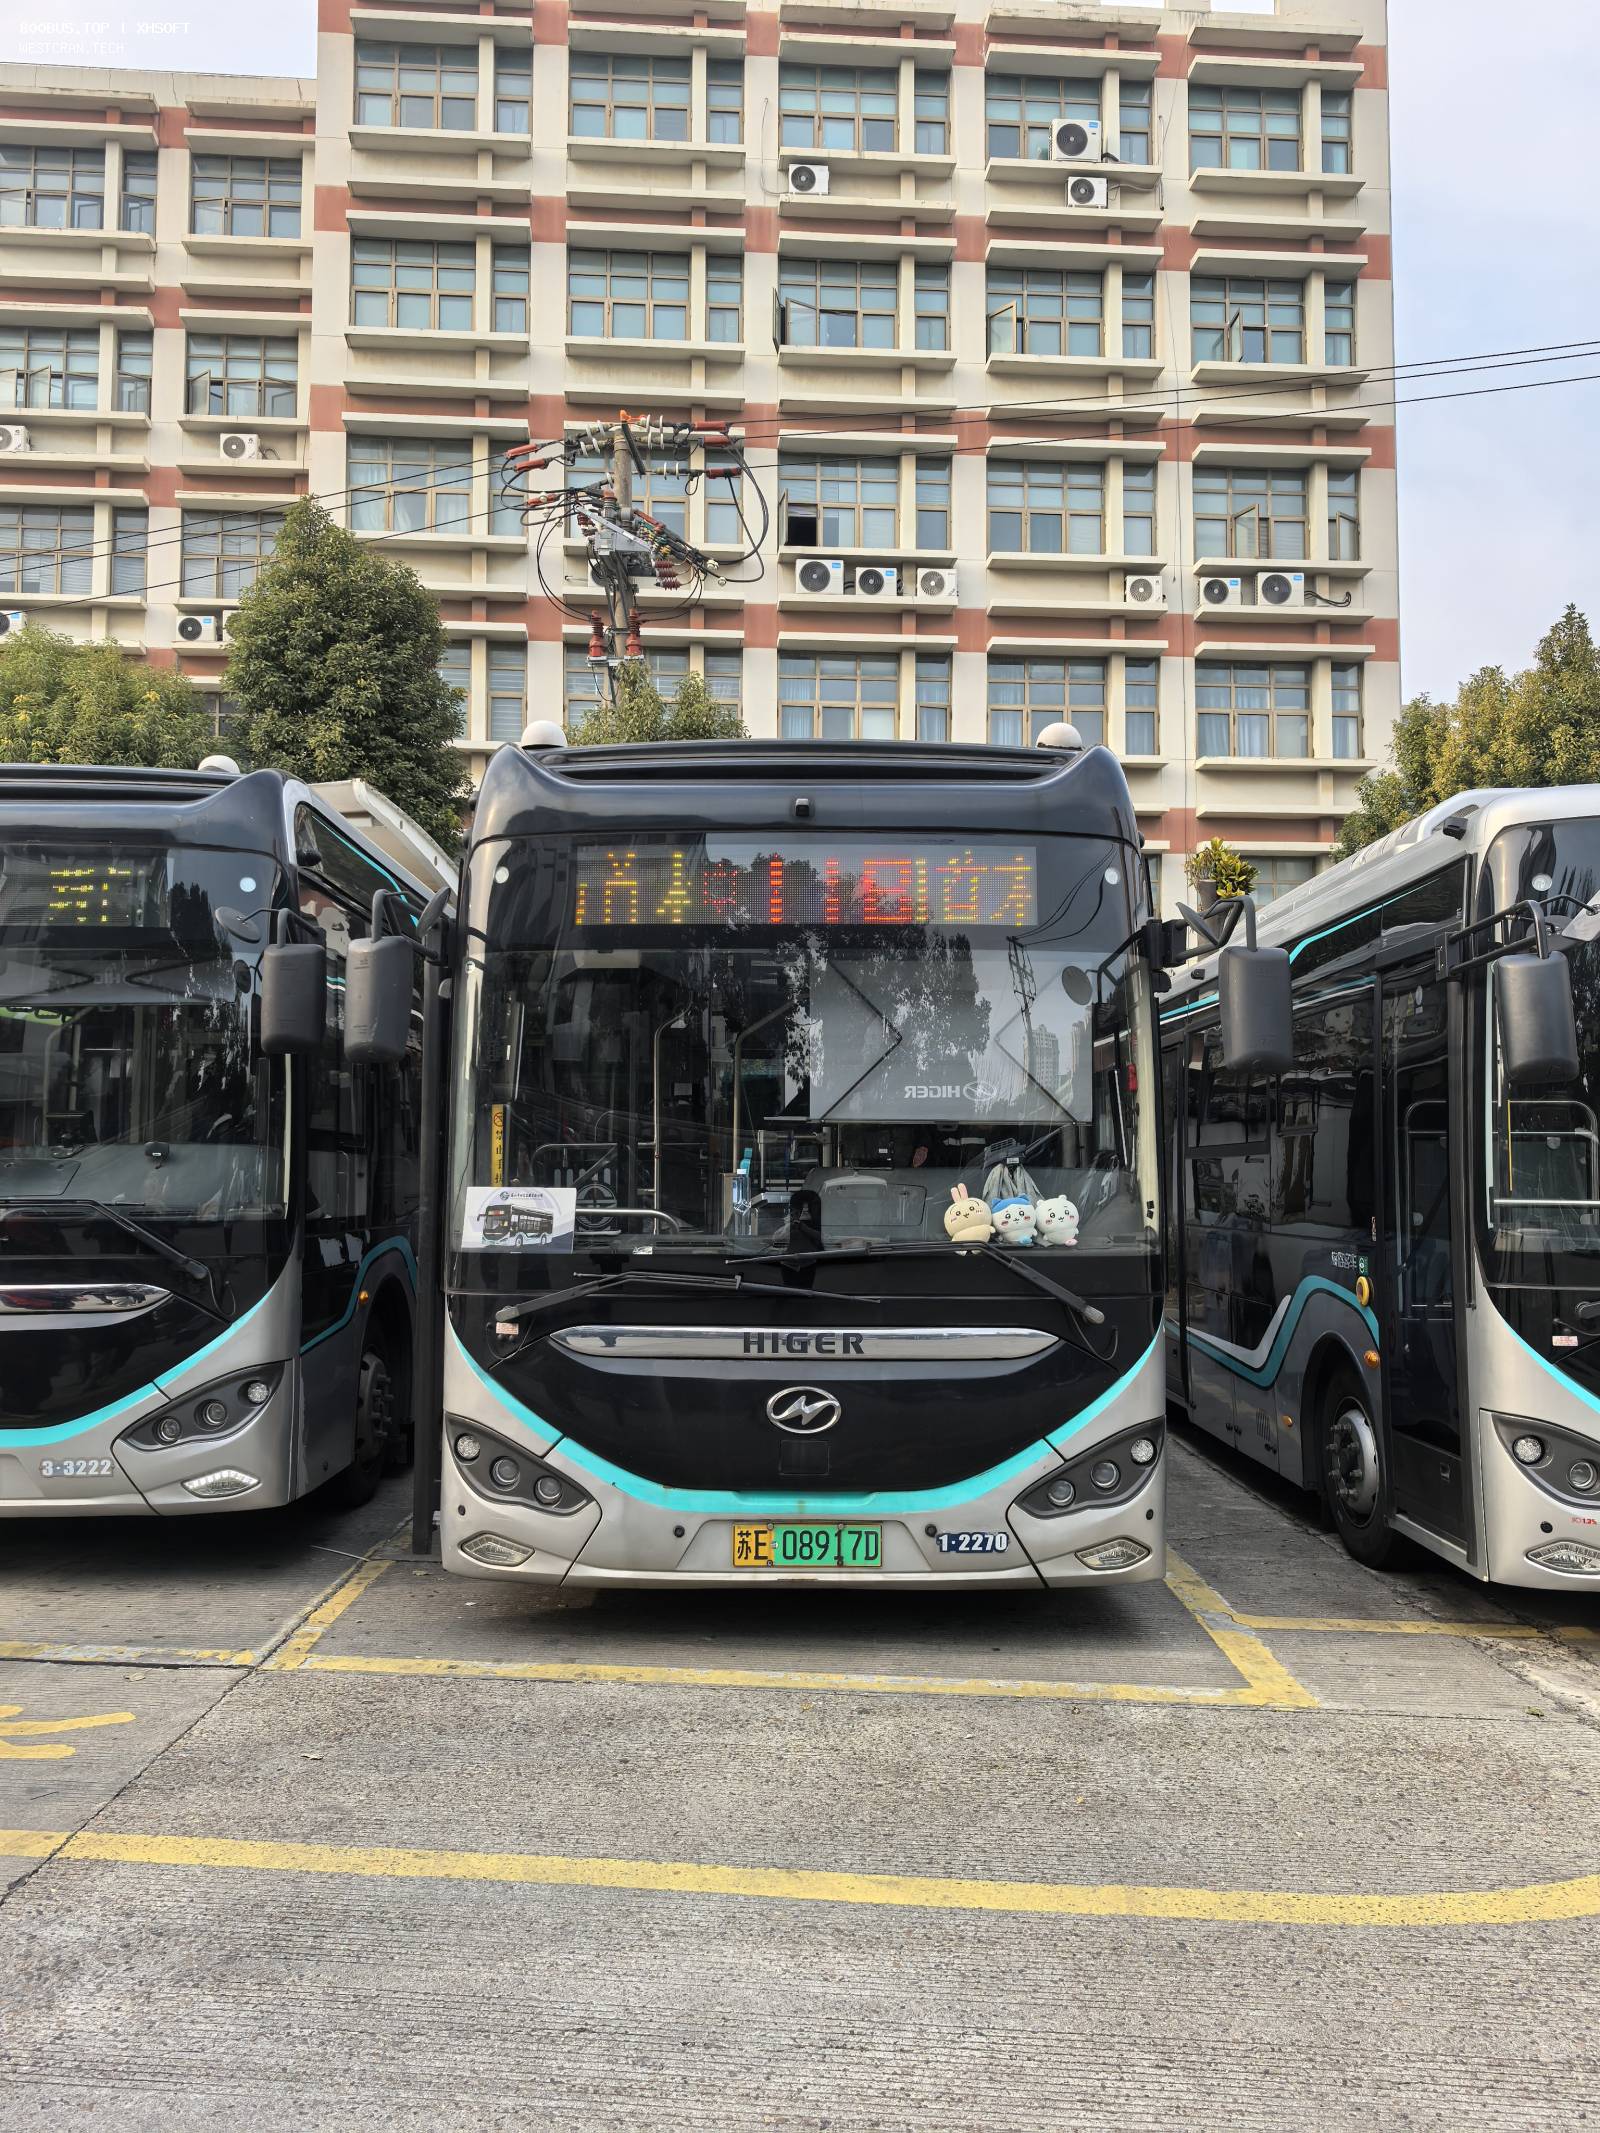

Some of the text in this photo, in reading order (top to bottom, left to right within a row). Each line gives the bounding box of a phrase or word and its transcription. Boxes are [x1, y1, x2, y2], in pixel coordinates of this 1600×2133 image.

[743, 1332, 865, 1354] HIGER
[737, 1529, 880, 1561] 苏E 08917D
